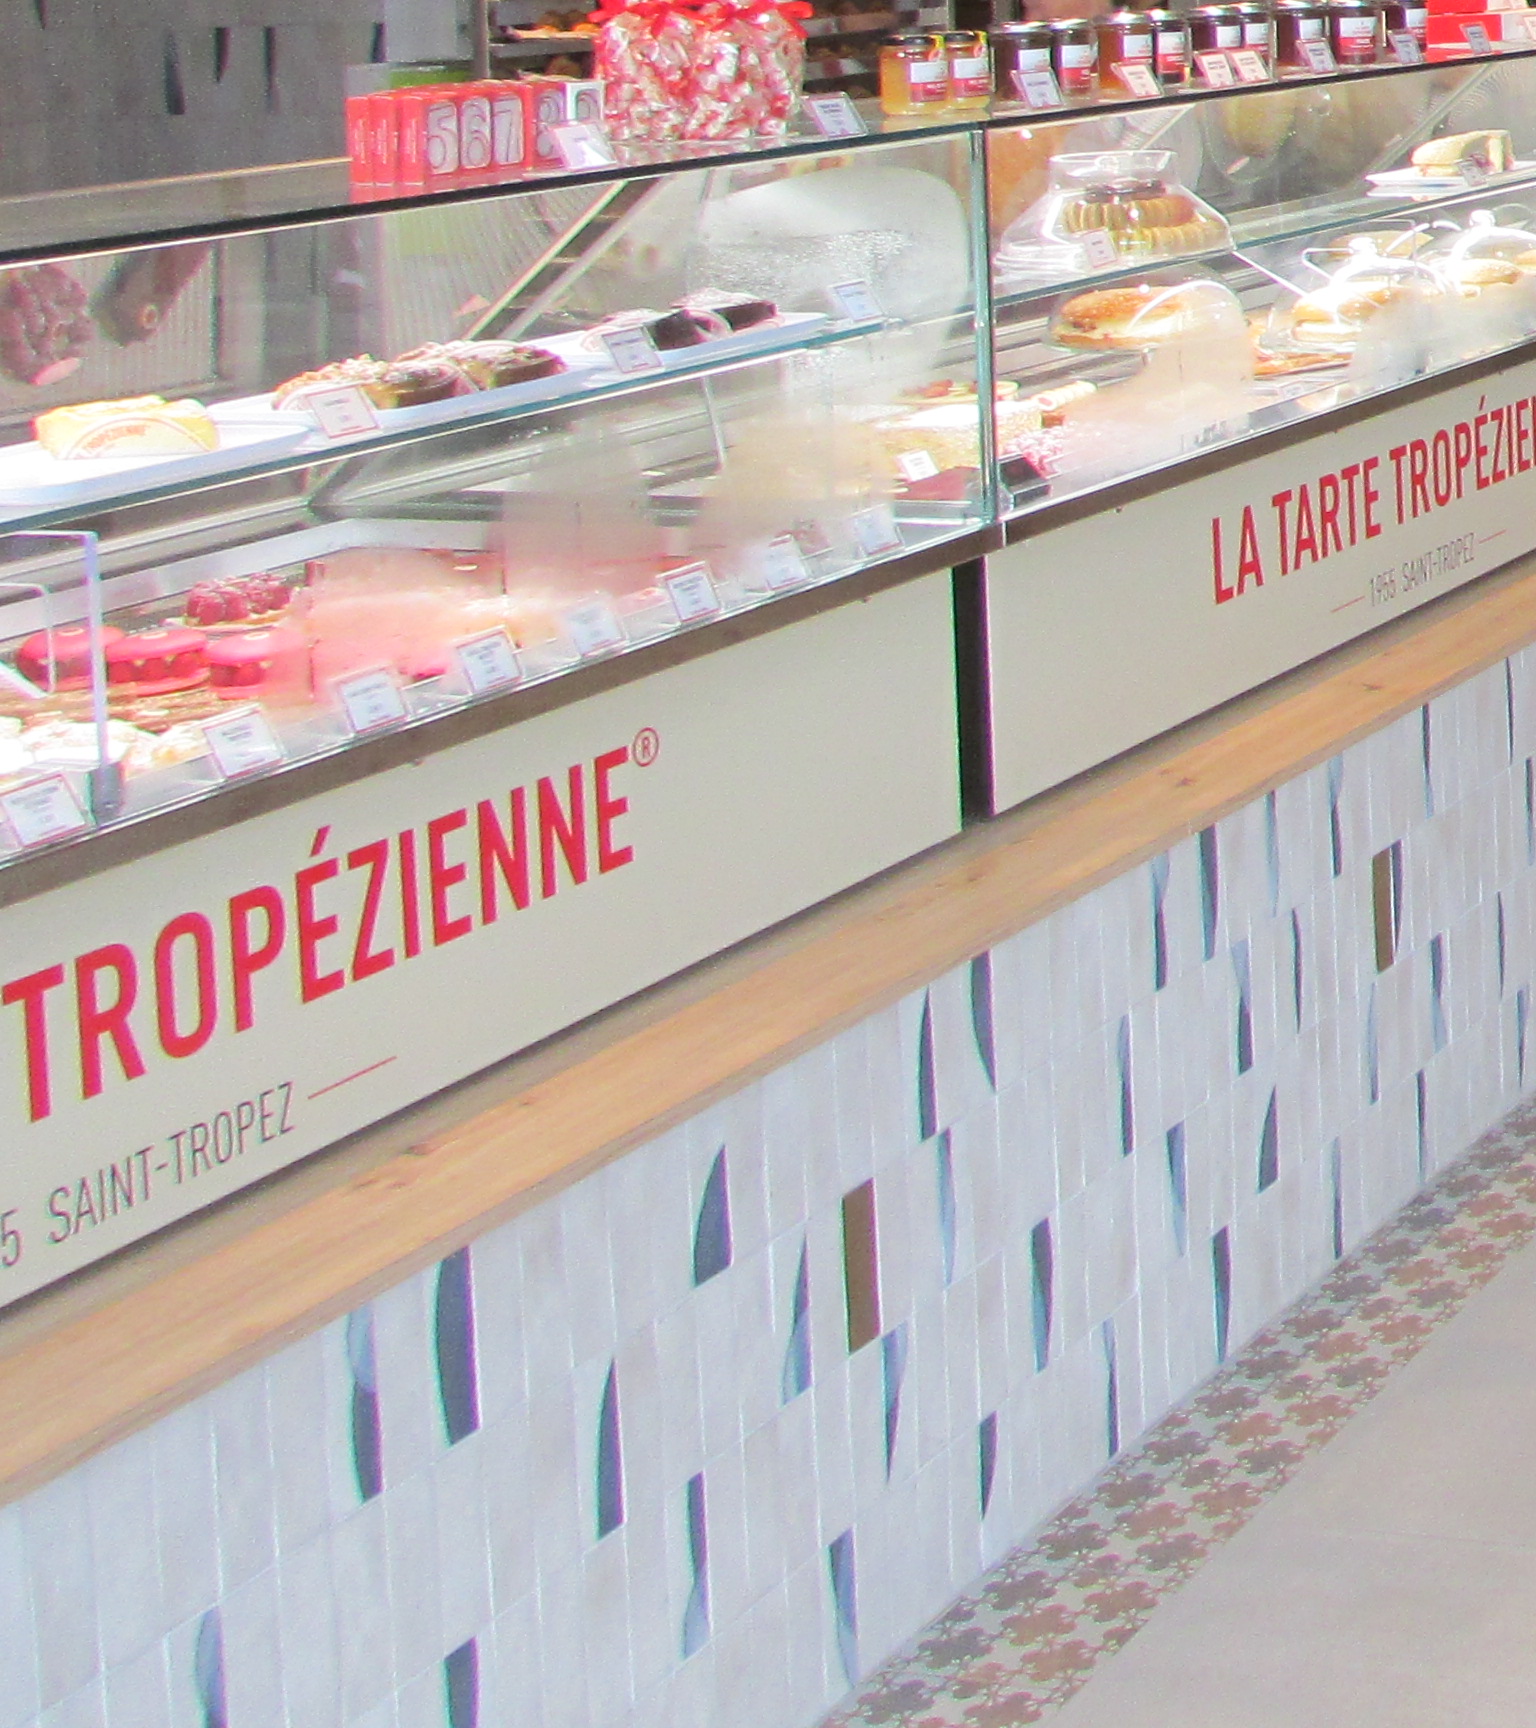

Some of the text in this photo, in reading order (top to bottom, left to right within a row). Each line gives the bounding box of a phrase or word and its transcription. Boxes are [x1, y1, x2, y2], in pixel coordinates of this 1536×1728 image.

[1212, 504, 1265, 606] LA
[1271, 456, 1382, 577] TARTE
[1371, 531, 1476, 608] 1955 SAINT-TROPEZ
[47, 1080, 296, 1245] SAINT-TROPEZ
